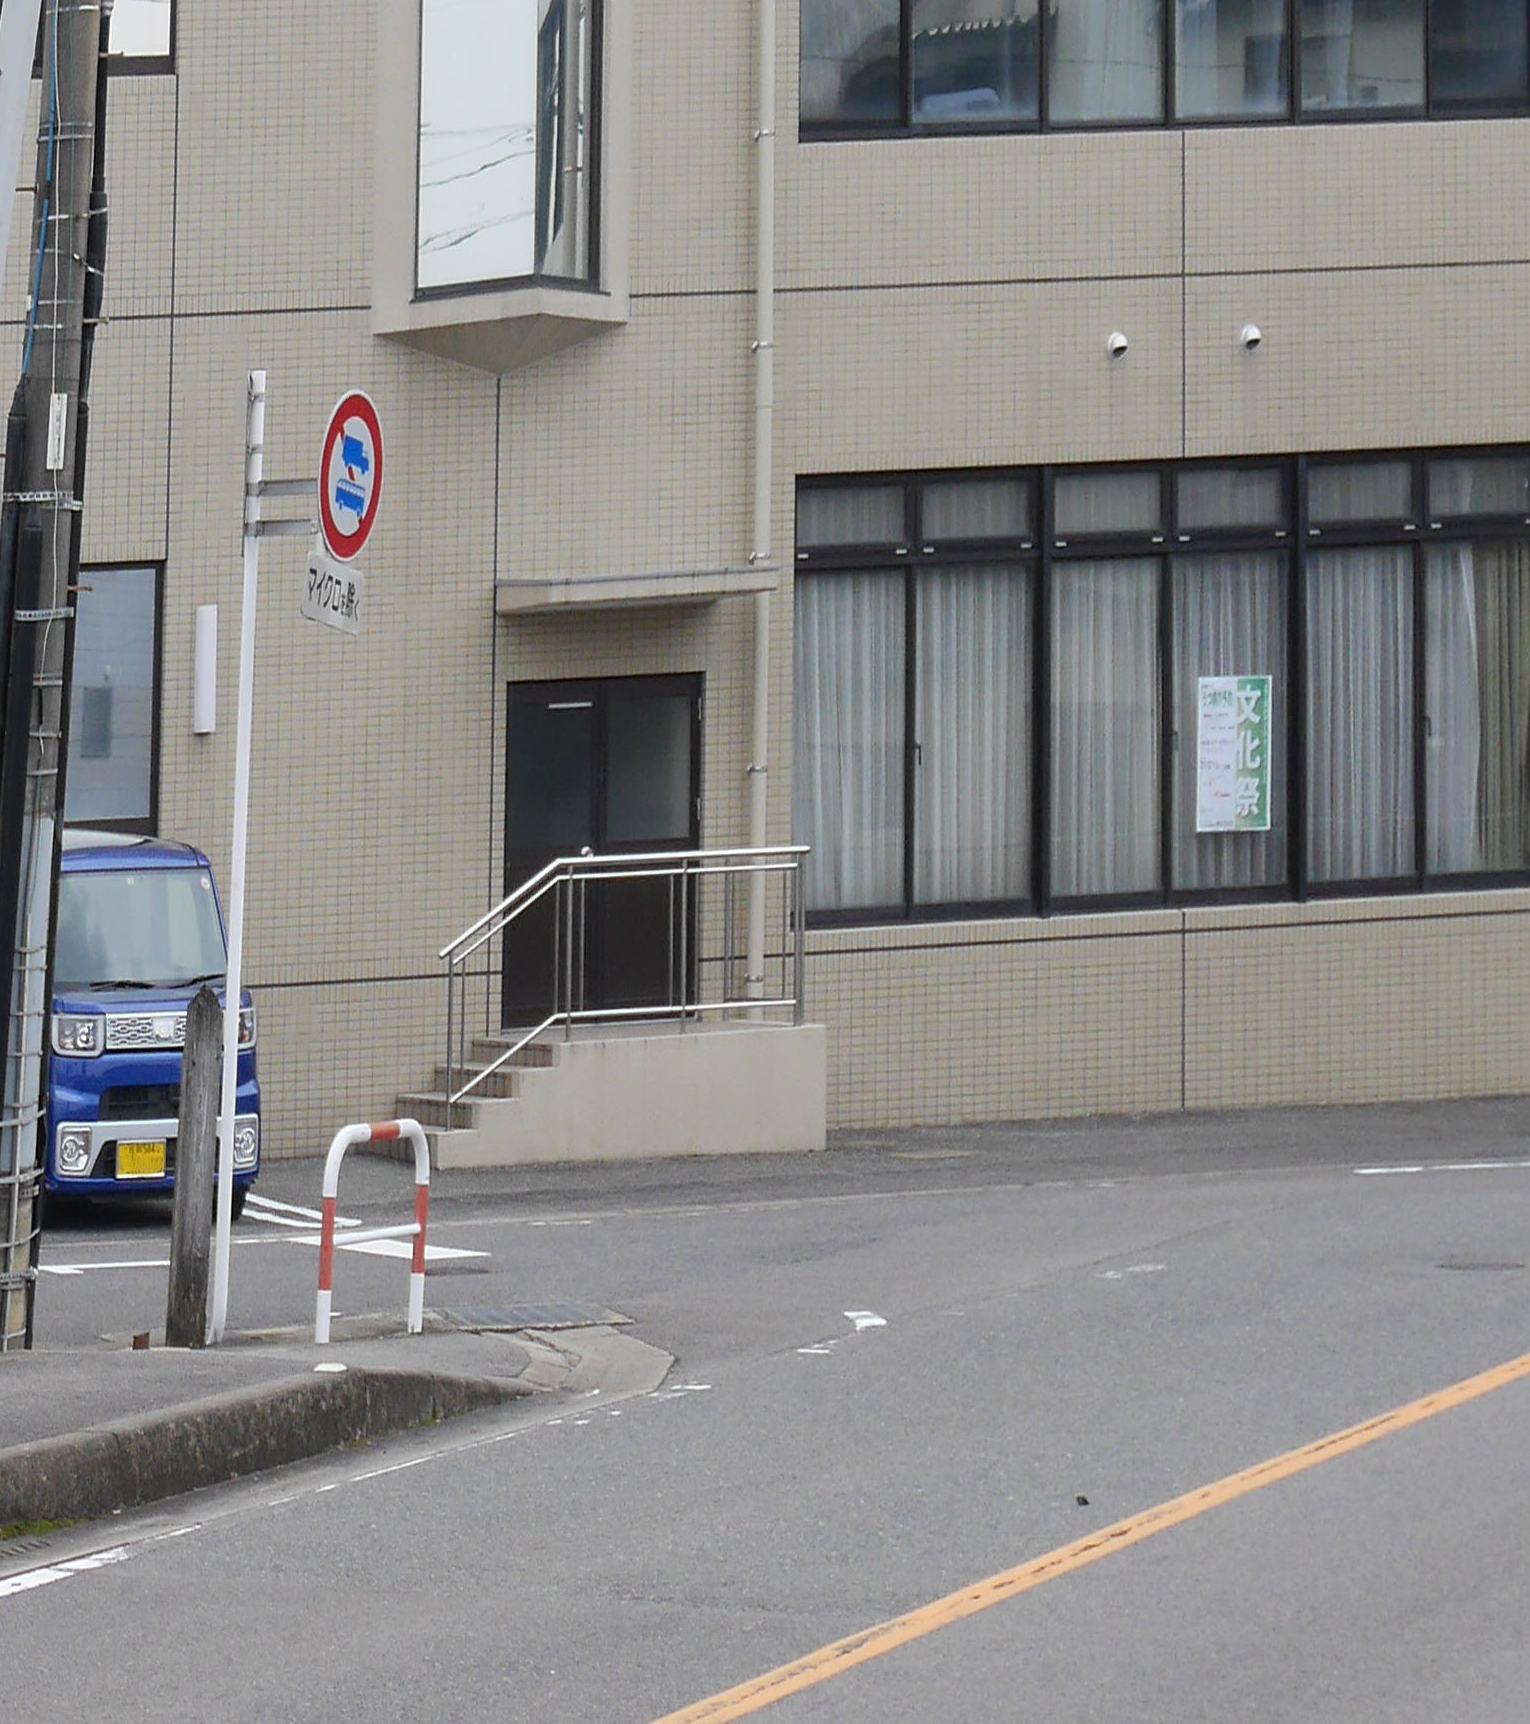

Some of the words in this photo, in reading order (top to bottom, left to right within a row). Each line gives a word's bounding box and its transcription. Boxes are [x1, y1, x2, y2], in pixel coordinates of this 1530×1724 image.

[309, 567, 360, 621] マイクロを除く
[1236, 683, 1261, 817] 文化祭
